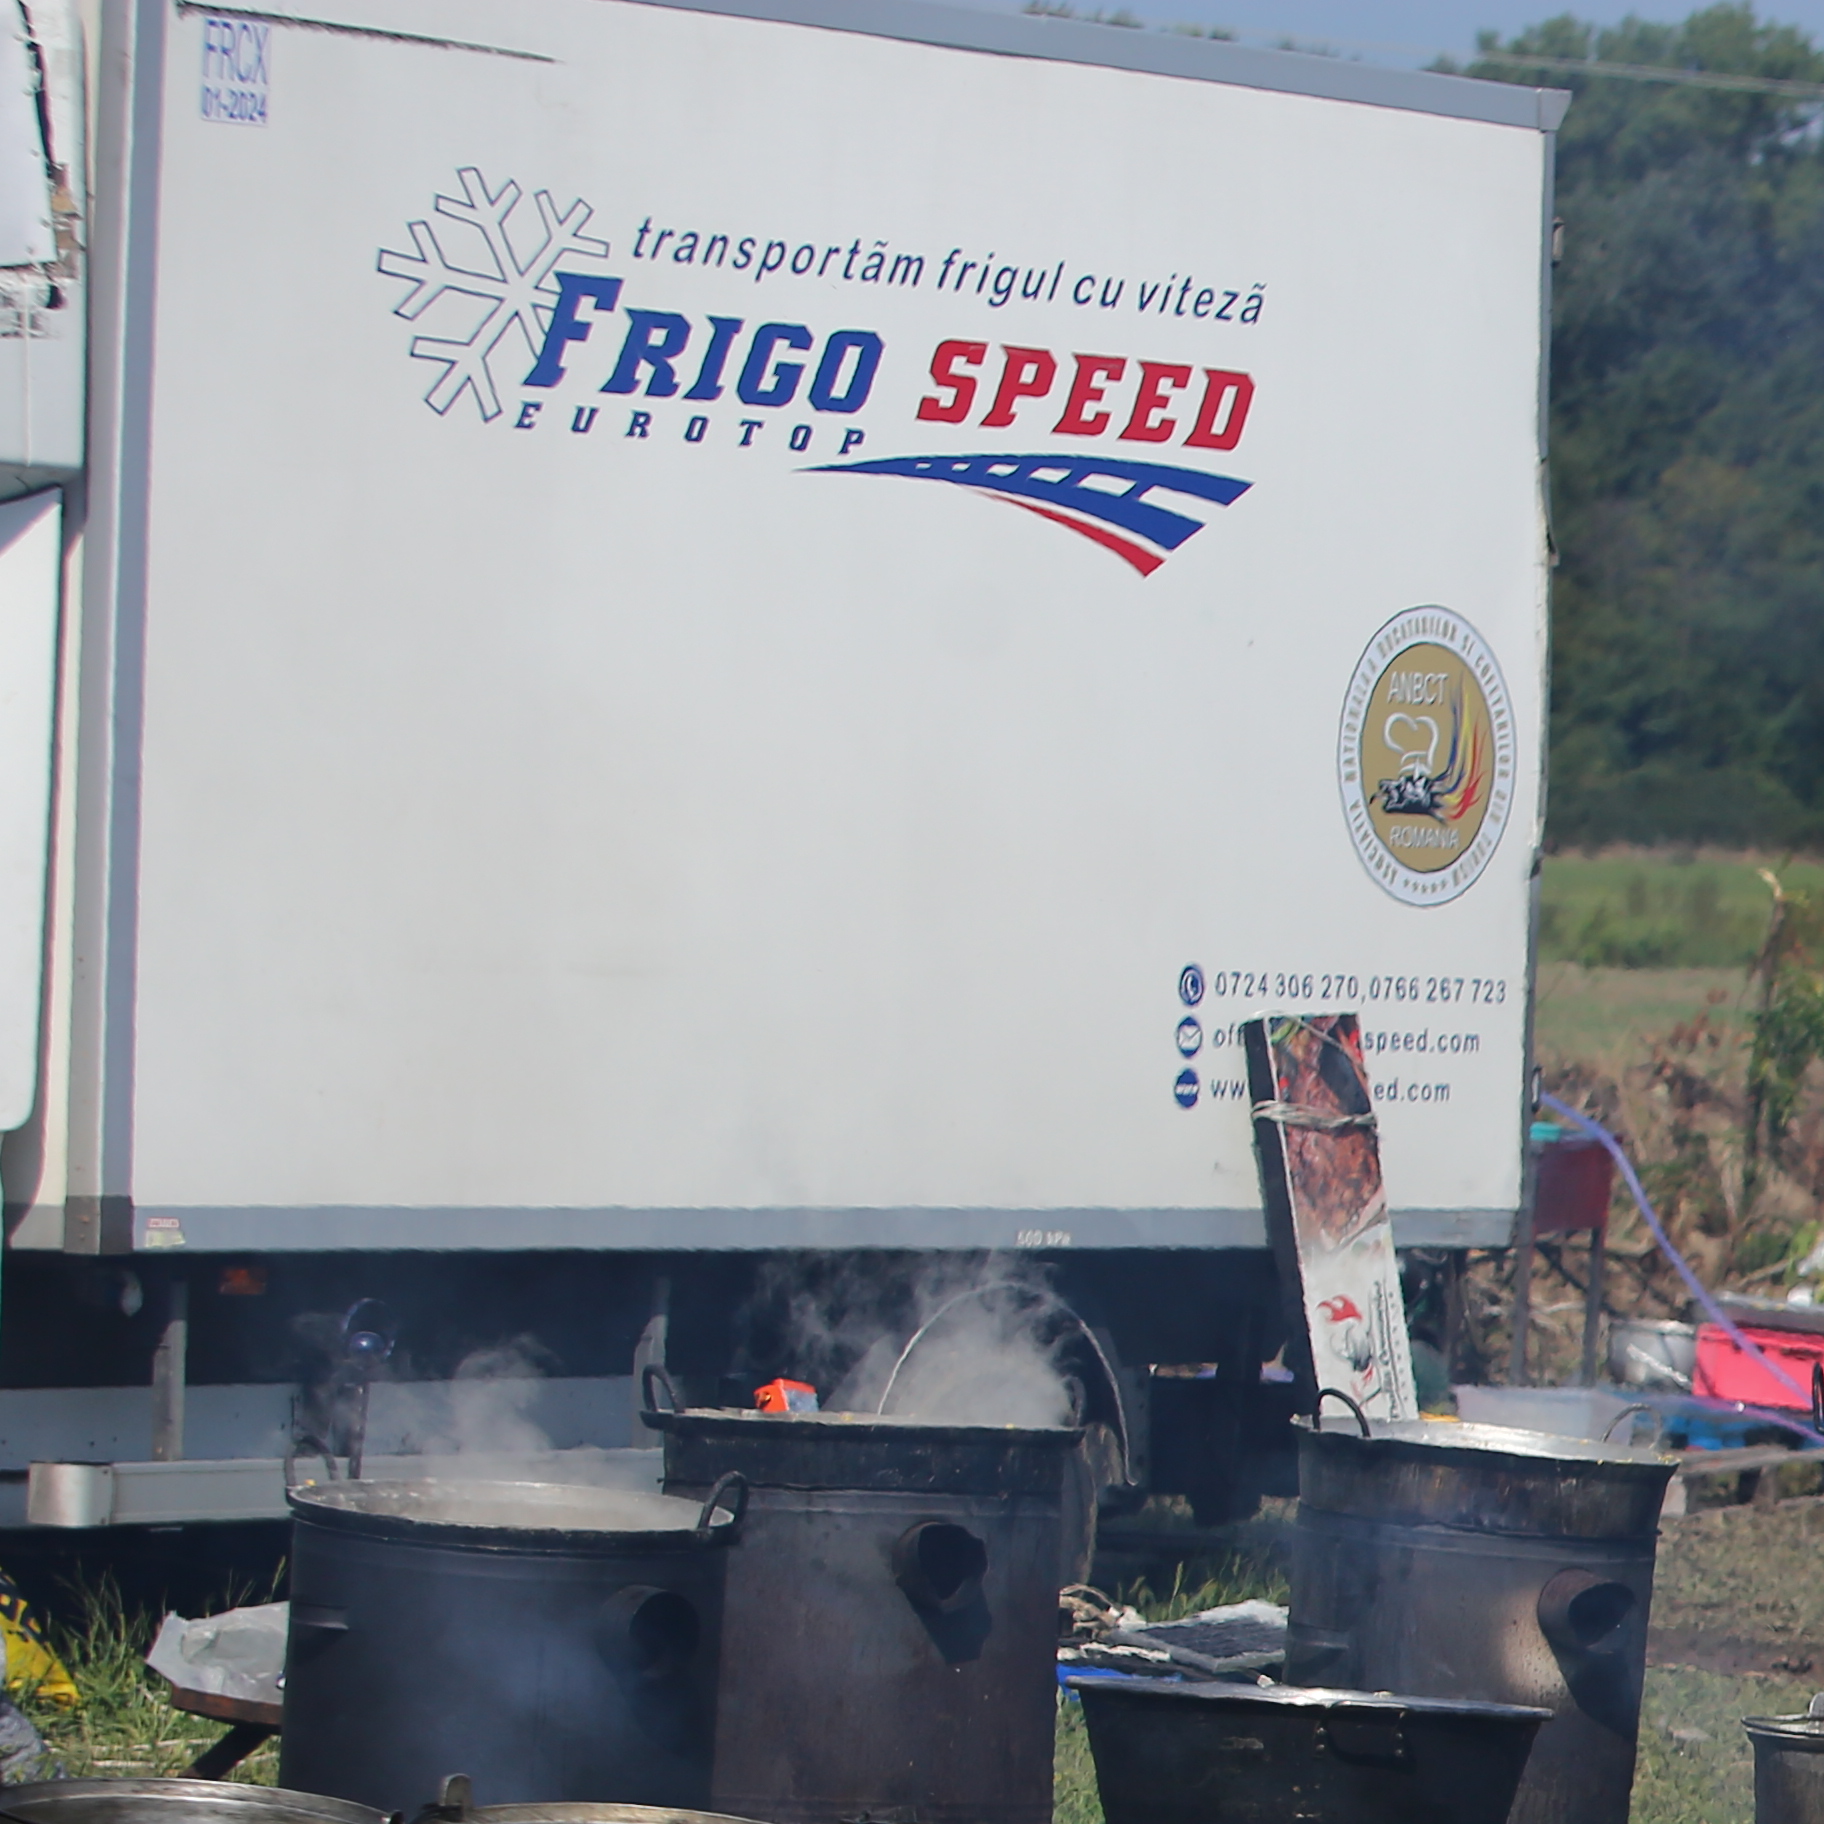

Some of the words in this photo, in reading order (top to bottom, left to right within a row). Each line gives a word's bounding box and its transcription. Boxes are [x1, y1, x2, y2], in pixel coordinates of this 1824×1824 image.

[203, 18, 268, 85] FRCX
[202, 86, 267, 122] 01-2024
[936, 247, 1066, 309] frigul
[1072, 272, 1126, 310] cu
[521, 270, 886, 414] FRIGO
[915, 338, 1256, 451] SPEED
[514, 401, 866, 455] EUROTOP
[1387, 671, 1449, 705] ANBCT
[1390, 825, 1461, 849] ROMANIA
[1215, 971, 1268, 998] 0724
[1275, 973, 1314, 998] 306
[1426, 976, 1465, 1003] 267
[1472, 979, 1507, 1004] 723
